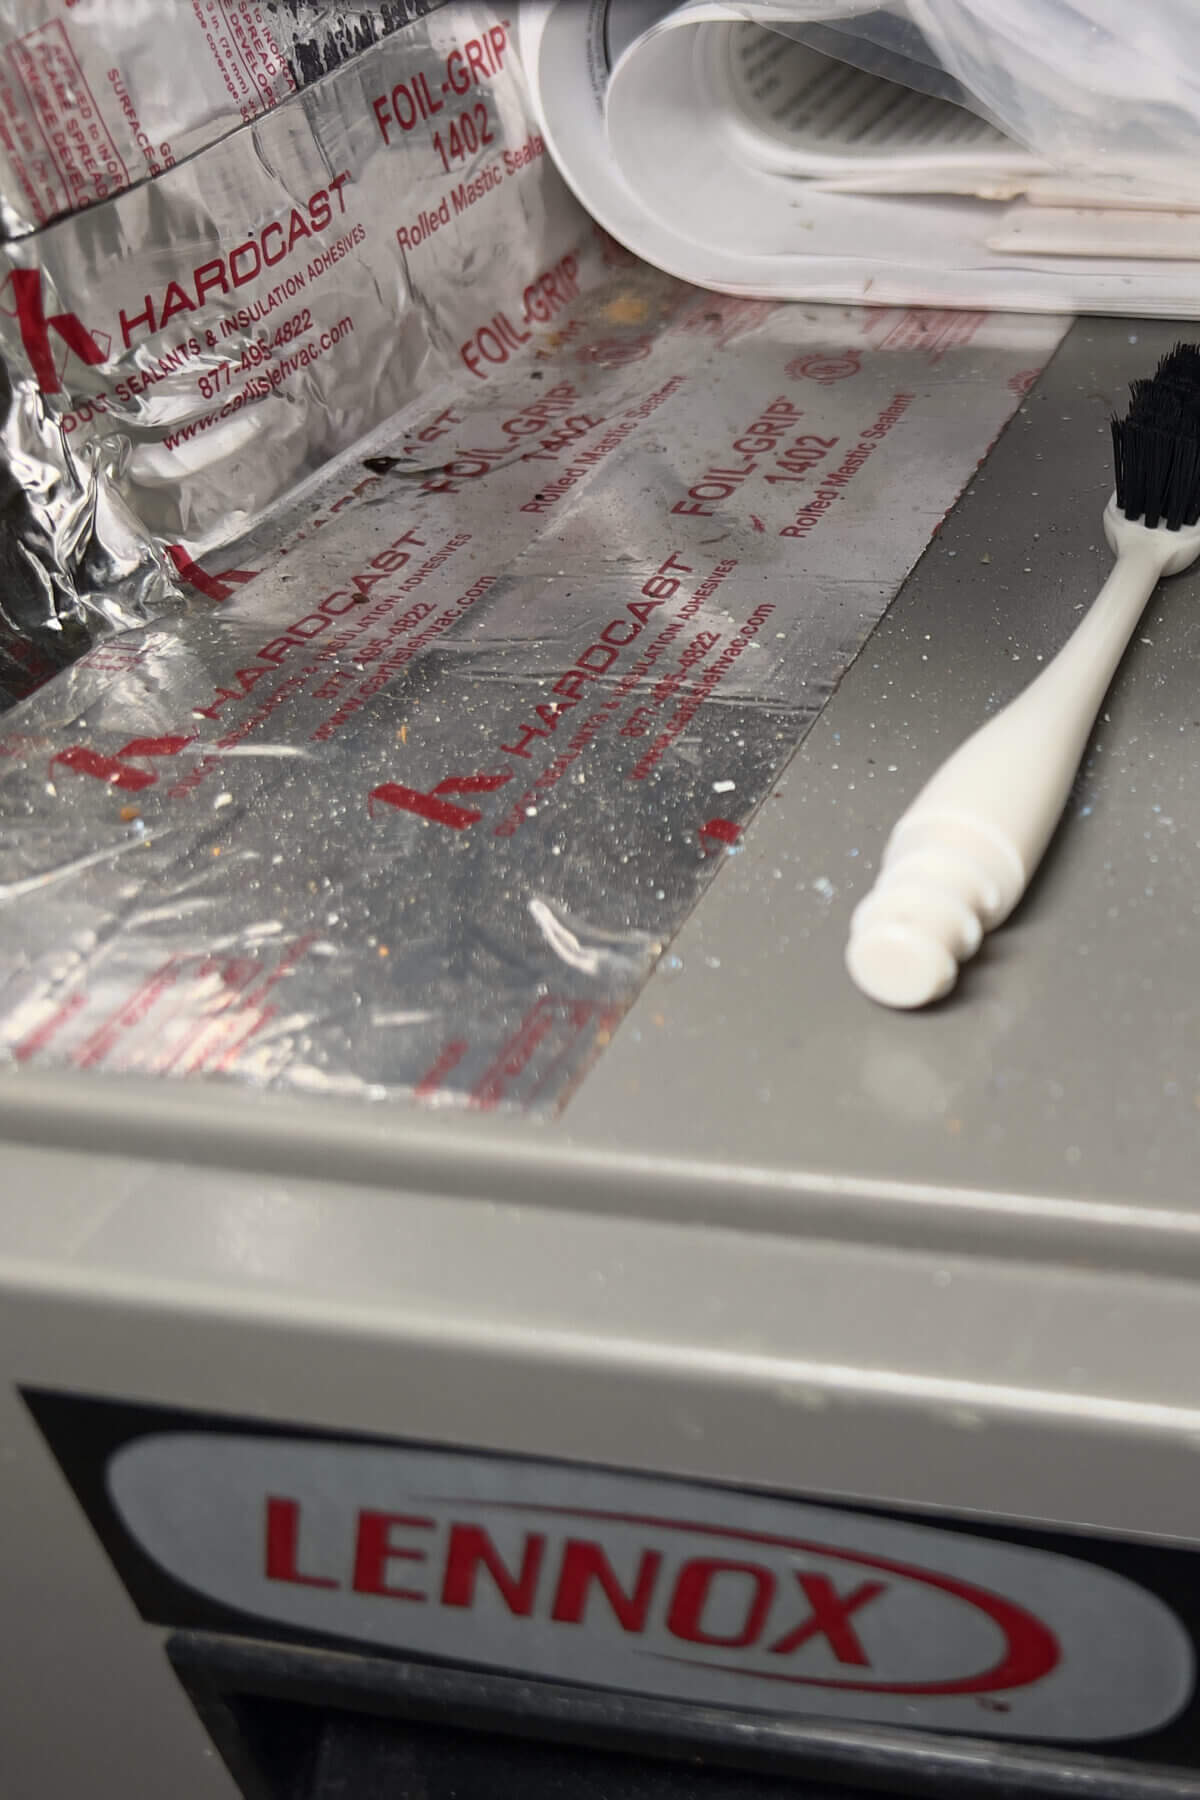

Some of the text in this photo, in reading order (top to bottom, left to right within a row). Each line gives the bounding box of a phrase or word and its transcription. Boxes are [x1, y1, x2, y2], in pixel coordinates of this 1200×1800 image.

[239, 0, 277, 76] SPREAD
[262, 27, 297, 93] INORGA
[372, 25, 508, 145] FOIL-GRIP
[67, 119, 108, 198] SPREAD
[107, 68, 156, 161] SURFACE
[433, 103, 495, 173] 1402
[396, 135, 544, 254] Rolled Mastic Seala
[115, 338, 201, 401] SEALANTS
[206, 329, 218, 349] &
[220, 271, 306, 341] INSULATION
[307, 223, 367, 282] ADHESIVES
[118, 174, 350, 349] HARDCAST
[162, 316, 355, 451] www.carlislehvac.com
[197, 308, 313, 400] 877-495-4822
[520, 466, 587, 514] Rolled
[574, 419, 638, 467] Mastic
[671, 402, 805, 517] FOIL-GRIP
[763, 435, 840, 485] 1402
[780, 392, 916, 538] Rolled Mastic Sealant
[193, 531, 427, 720] HARDCAST
[313, 594, 400, 662] INSULATION
[399, 533, 473, 598] ADHESIVES
[677, 559, 739, 621] ADHESIVES
[310, 575, 497, 742] www.carlislehvac.com
[500, 554, 693, 760] HARDCAST
[263, 1496, 892, 1668] LENNOX
